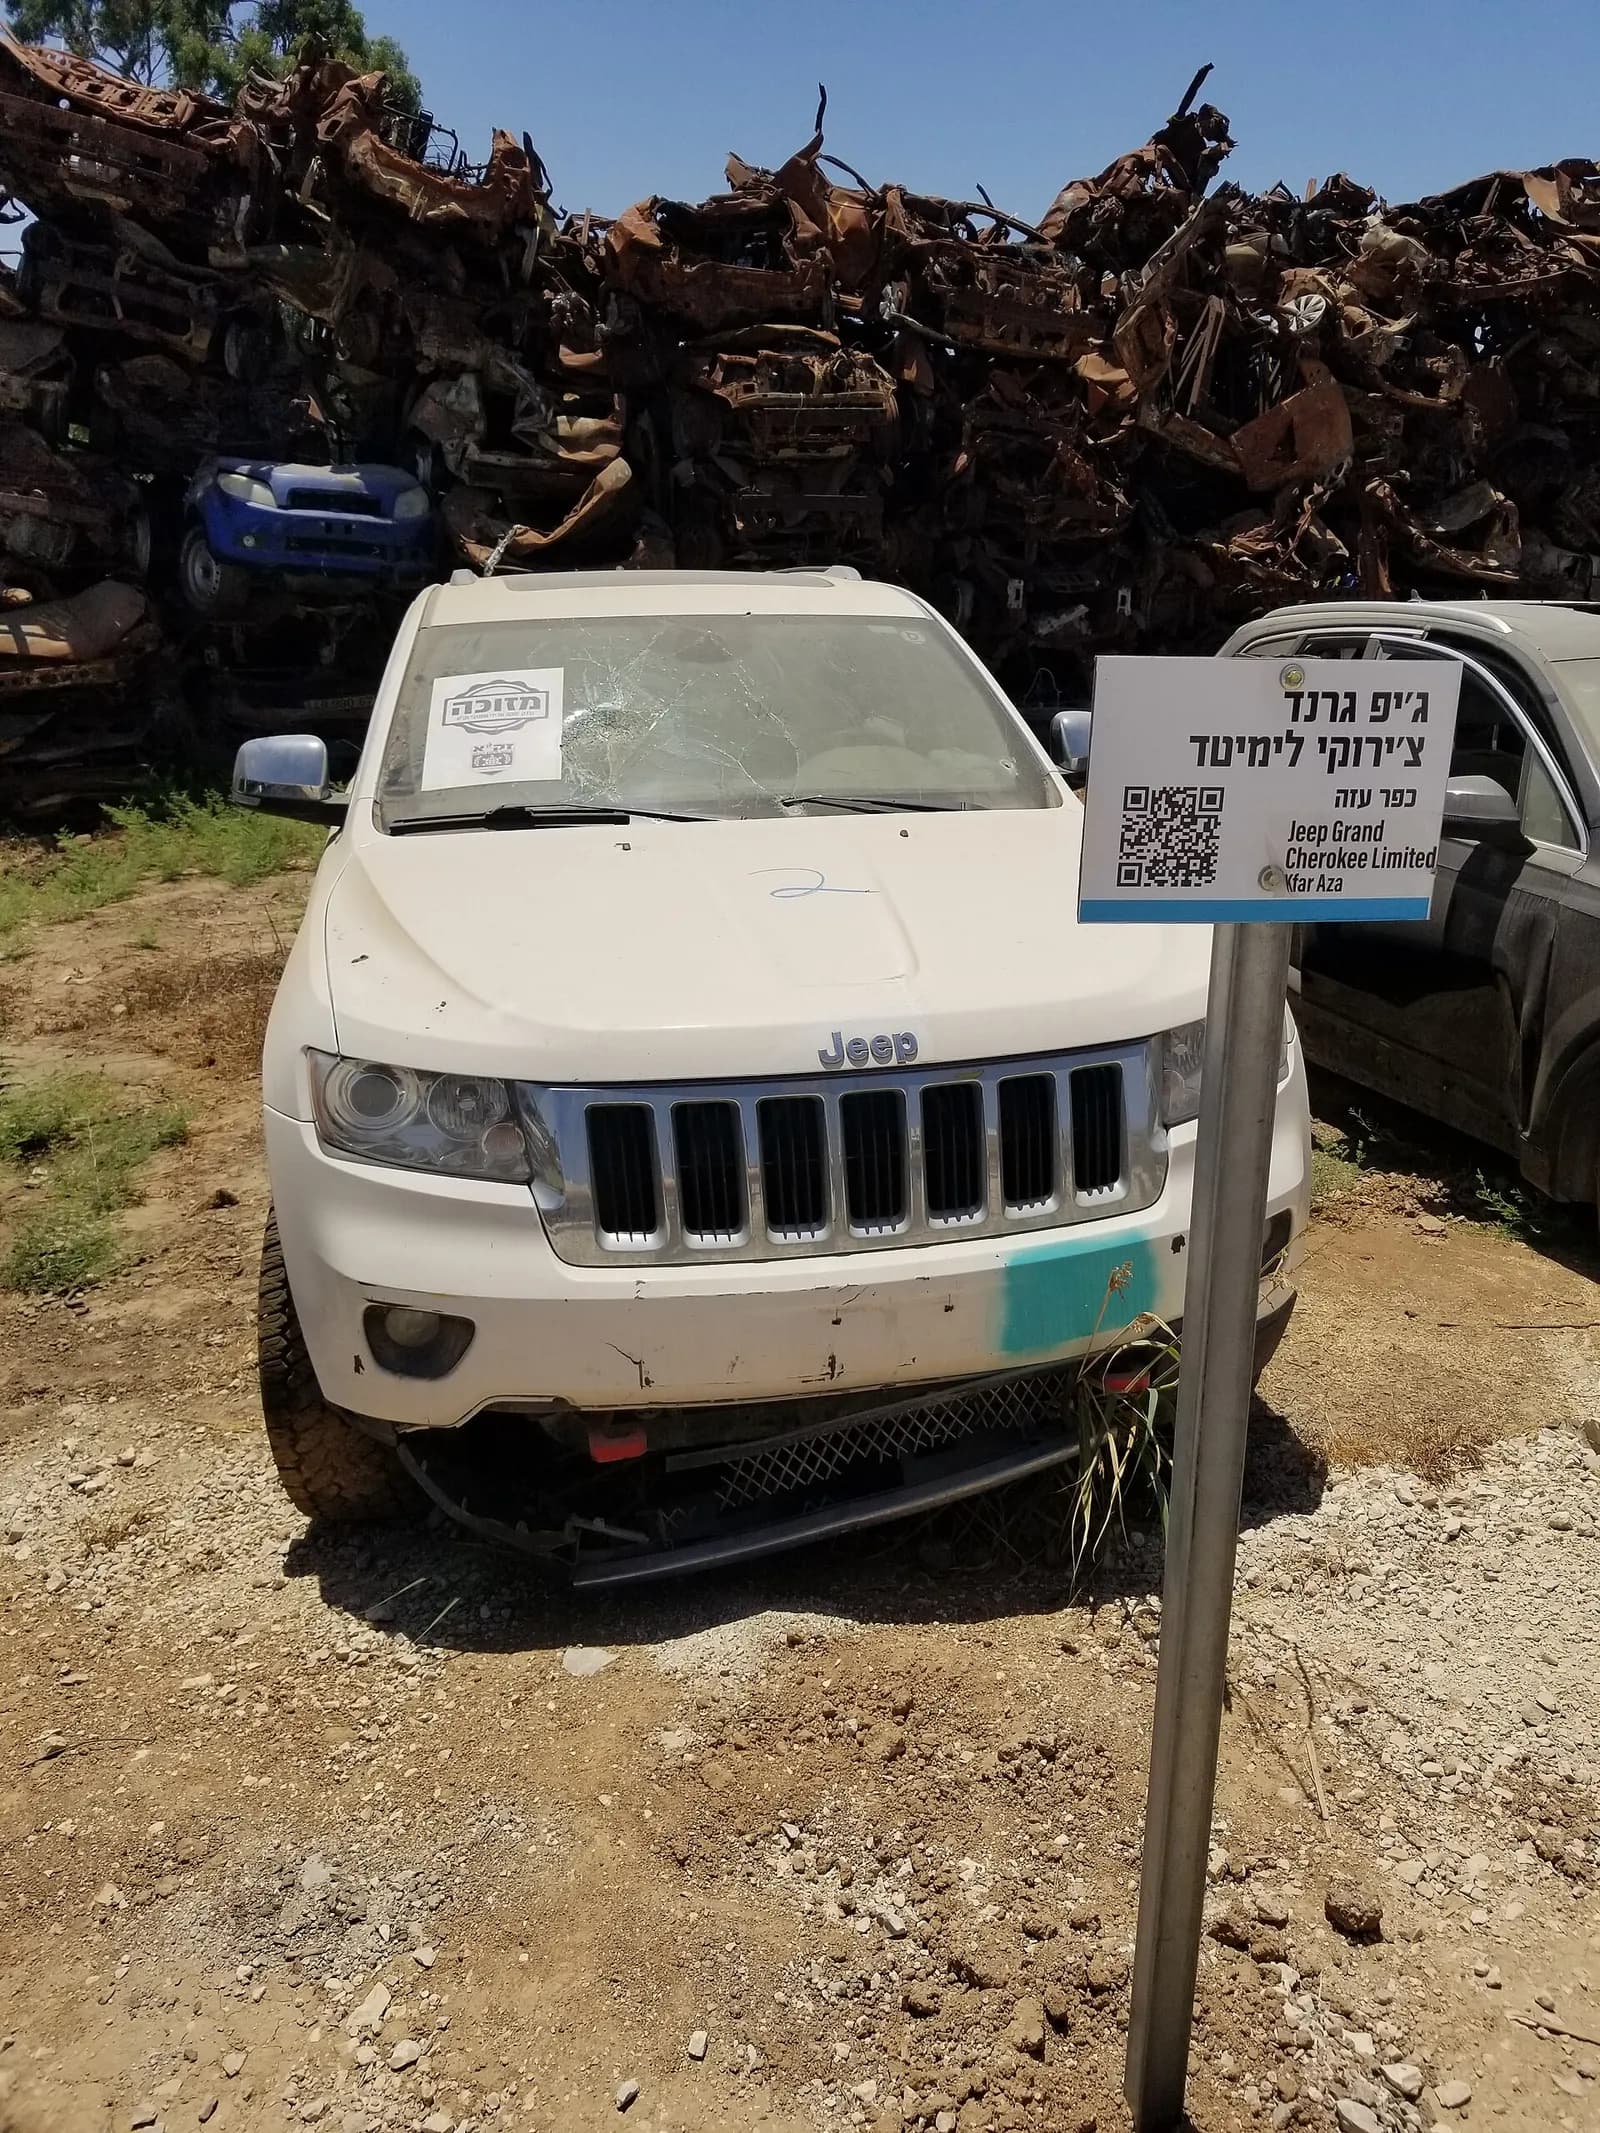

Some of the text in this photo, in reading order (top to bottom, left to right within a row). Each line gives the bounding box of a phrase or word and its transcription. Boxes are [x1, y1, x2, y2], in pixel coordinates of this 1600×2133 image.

[451, 696, 541, 716] מזוכה
[1284, 691, 1356, 723] גרנד
[1189, 730, 1305, 767] לימיטד
[1334, 788, 1417, 810] כפר עזה
[1287, 819, 1385, 847] Jeep Grand
[1285, 846, 1437, 870] Cherokee Limited
[1284, 874, 1343, 893] Kfar Aza
[818, 1031, 918, 1070] Jeep
